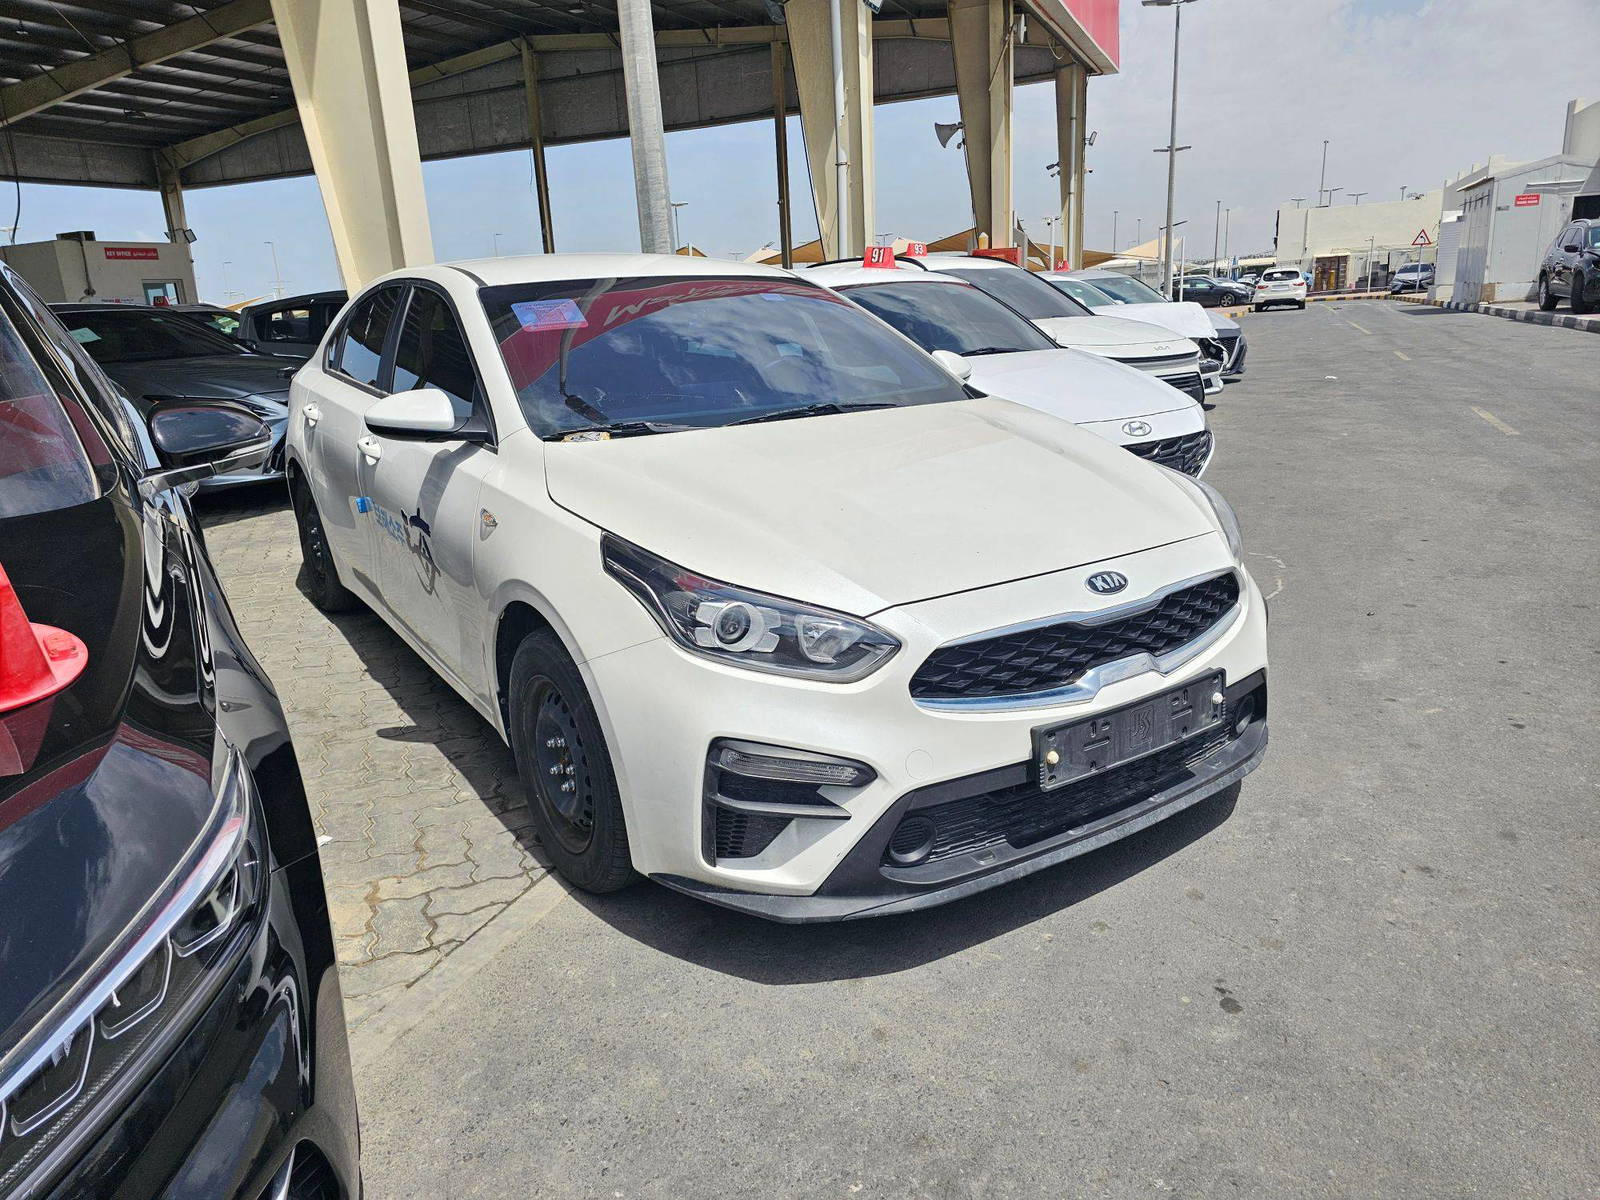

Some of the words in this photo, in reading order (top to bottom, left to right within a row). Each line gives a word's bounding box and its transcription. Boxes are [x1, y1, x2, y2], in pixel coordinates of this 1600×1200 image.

[871, 247, 885, 263] 91
[914, 243, 924, 255] 93
[1090, 572, 1126, 591] KIA
